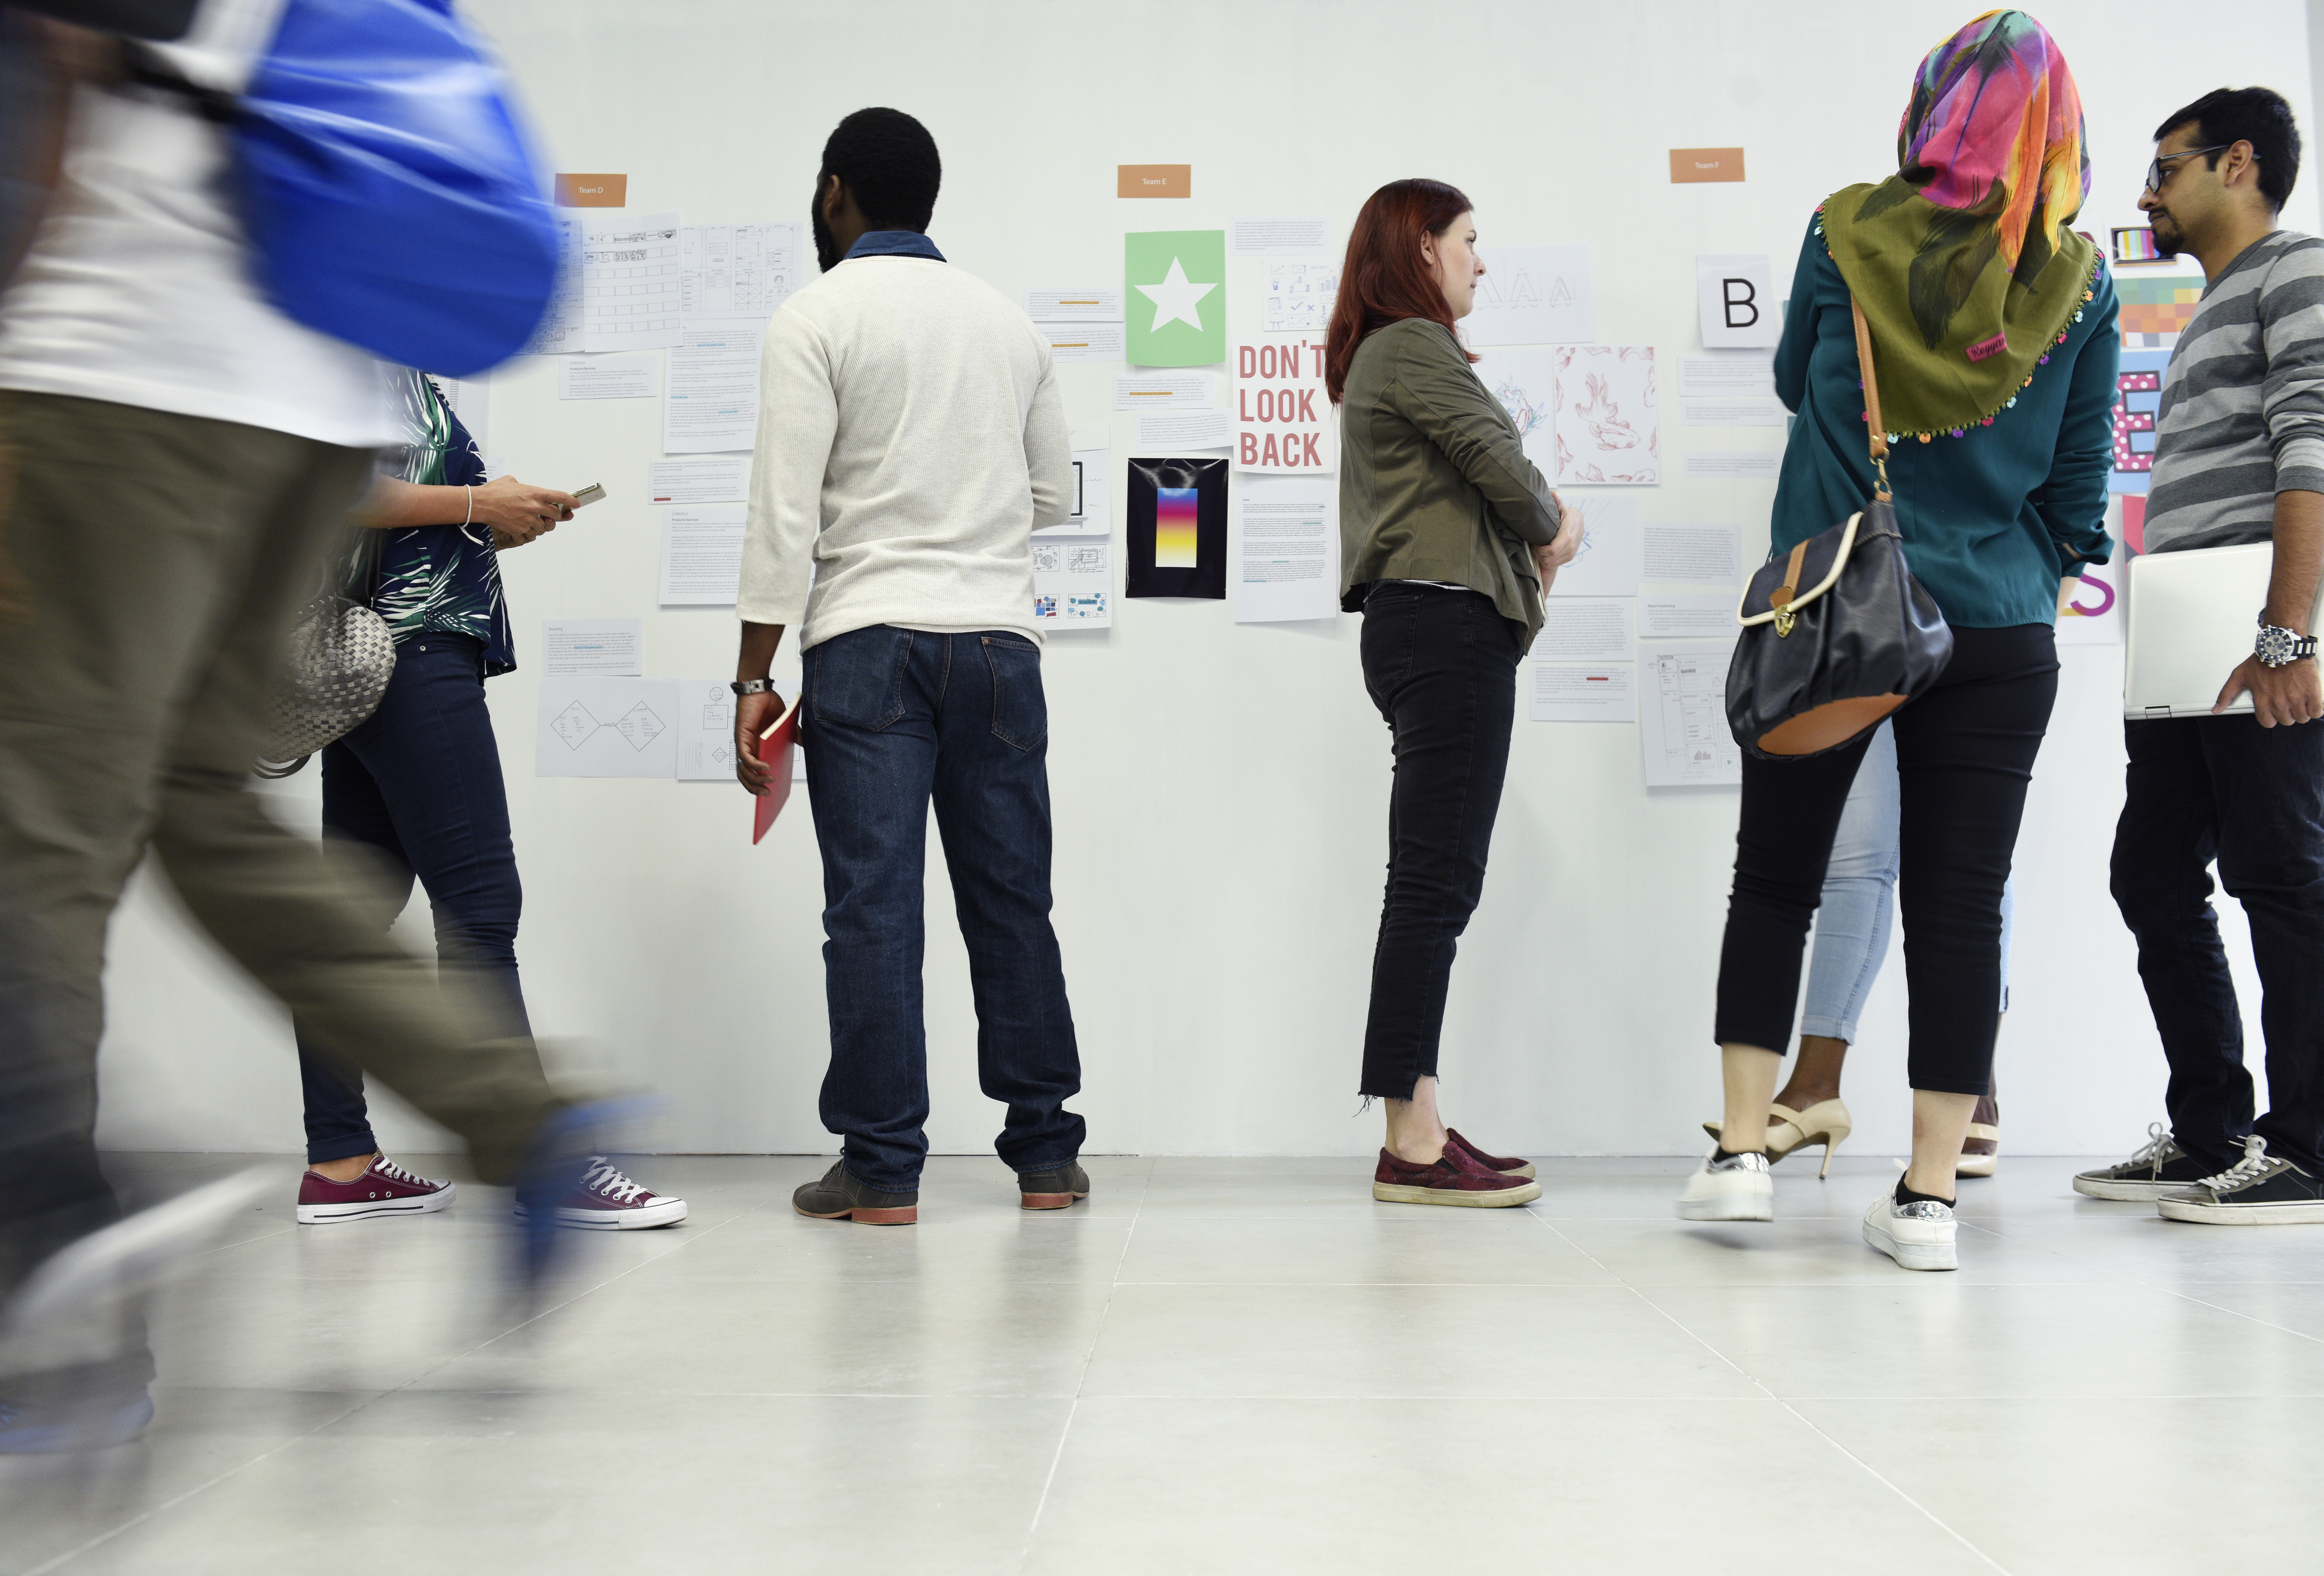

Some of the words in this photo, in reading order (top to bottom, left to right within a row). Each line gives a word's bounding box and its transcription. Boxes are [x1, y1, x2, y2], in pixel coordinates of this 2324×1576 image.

[1722, 278, 1759, 328] B
[1239, 340, 1326, 379] DON'T
[1240, 389, 1317, 423] LOOK
[2112, 370, 2161, 473] E
[1241, 432, 1322, 467] BACK
